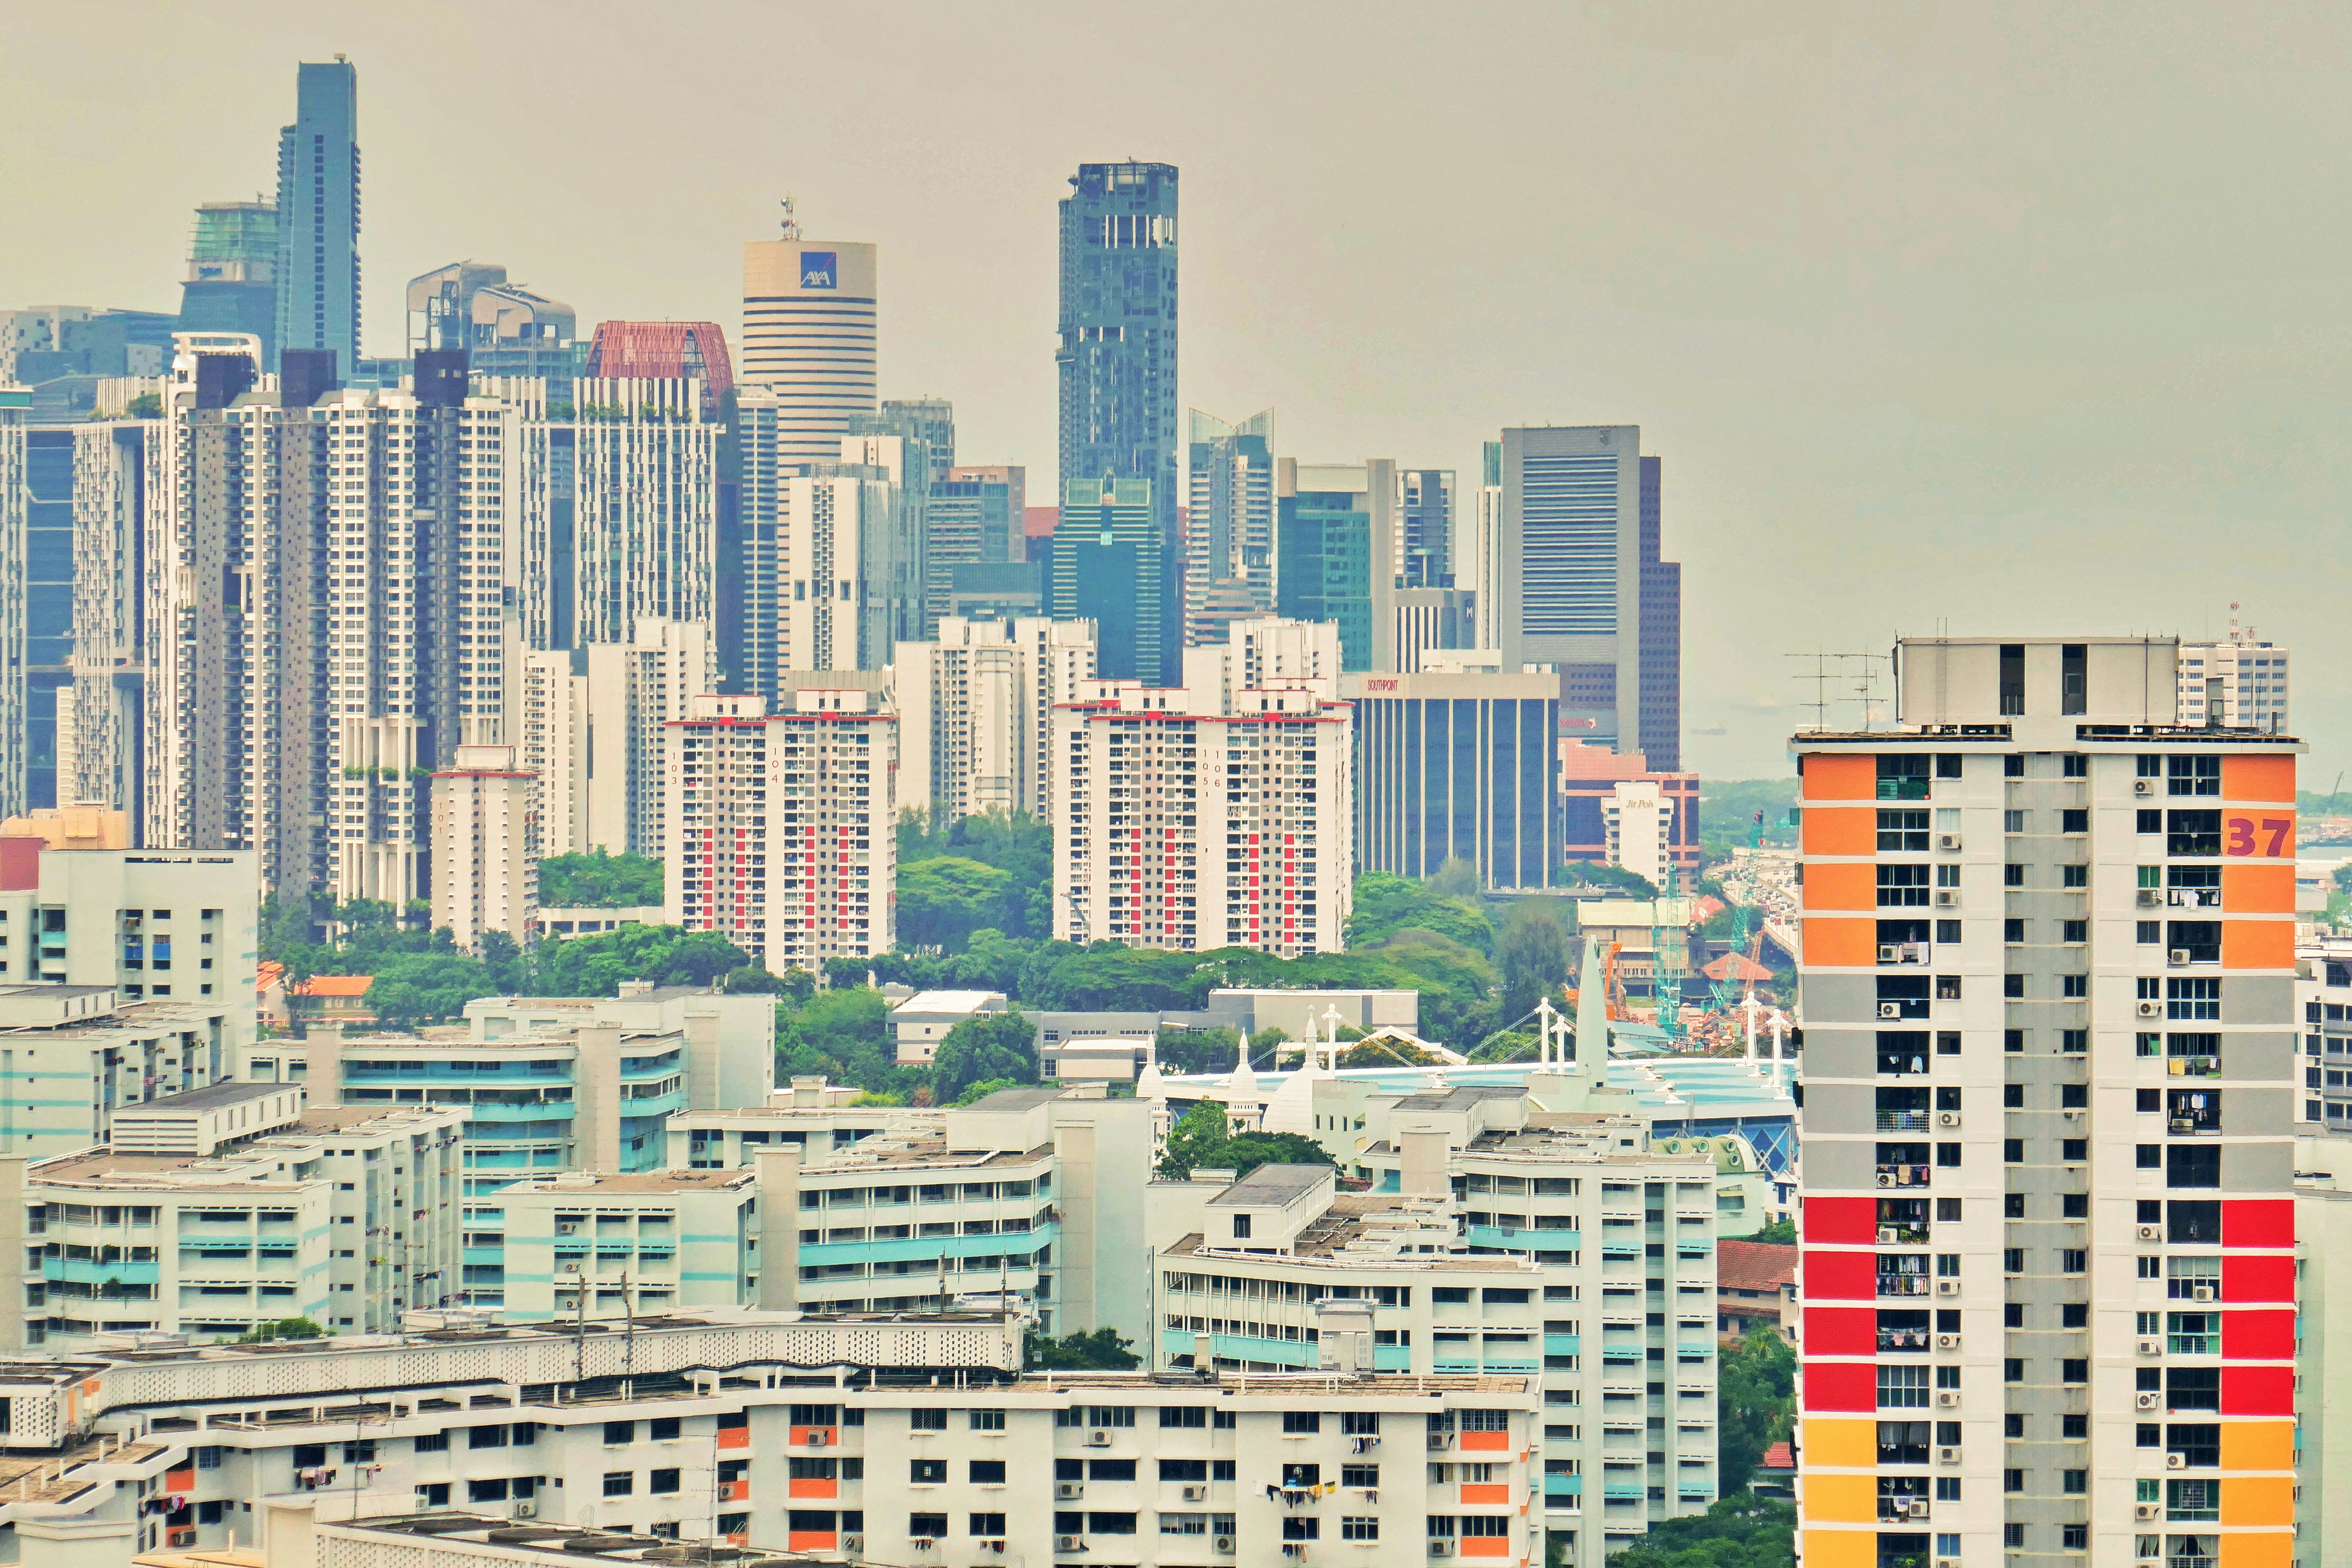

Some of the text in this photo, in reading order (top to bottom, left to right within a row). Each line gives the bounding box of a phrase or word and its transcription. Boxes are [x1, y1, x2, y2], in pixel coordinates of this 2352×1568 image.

[801, 271, 830, 285] AXA
[1466, 606, 1473, 618] M
[1368, 679, 1398, 691] SOUTHPOINT
[1626, 800, 1654, 808] Jit Poh
[2226, 818, 2291, 857] 37
